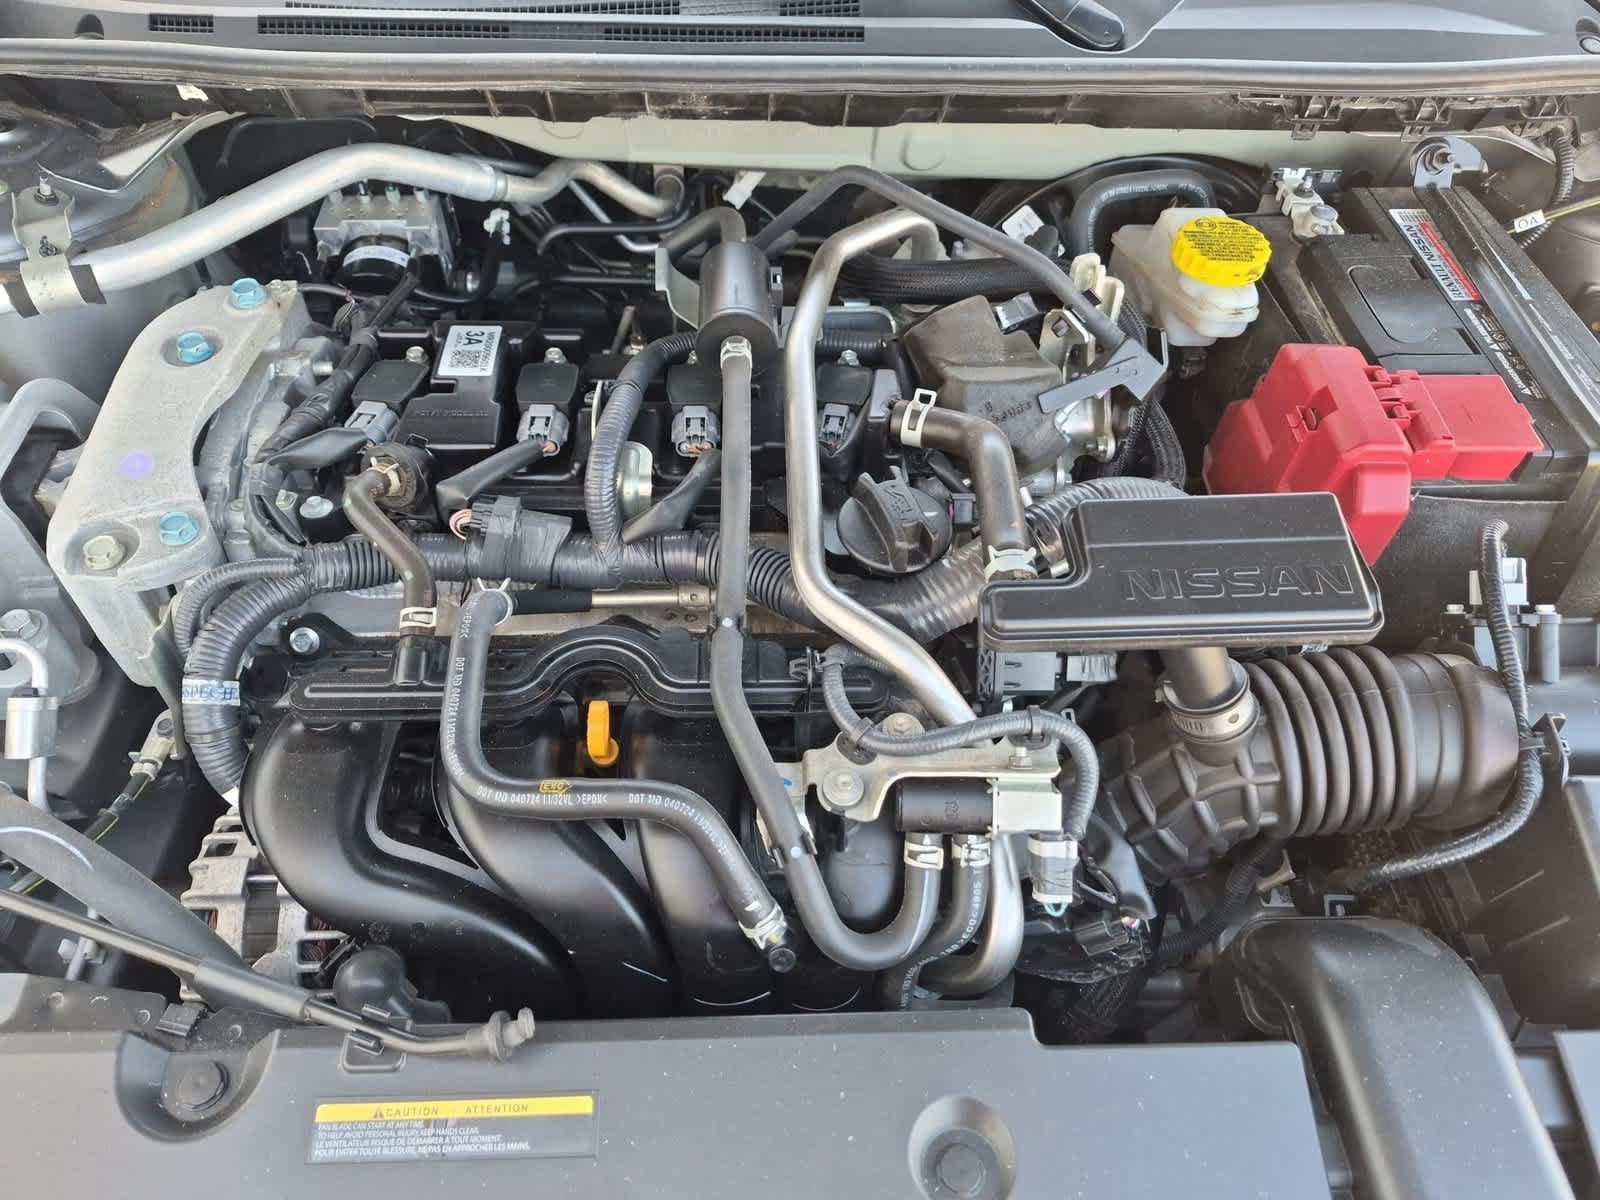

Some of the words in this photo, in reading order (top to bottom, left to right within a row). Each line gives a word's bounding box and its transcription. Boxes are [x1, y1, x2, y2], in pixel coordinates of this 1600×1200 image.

[1403, 224, 1436, 261] NISSAN
[1431, 264, 1464, 298] RENAULT
[462, 331, 485, 345] 3A
[1120, 564, 1354, 600] NISSAN
[628, 793, 644, 804] DOT
[385, 1105, 439, 1117] CAUTION
[465, 1103, 529, 1114] ATTENTION
[366, 1130, 396, 1138] PERSONAL
[420, 1128, 435, 1136] KEEP
[436, 1128, 458, 1136] HANDS
